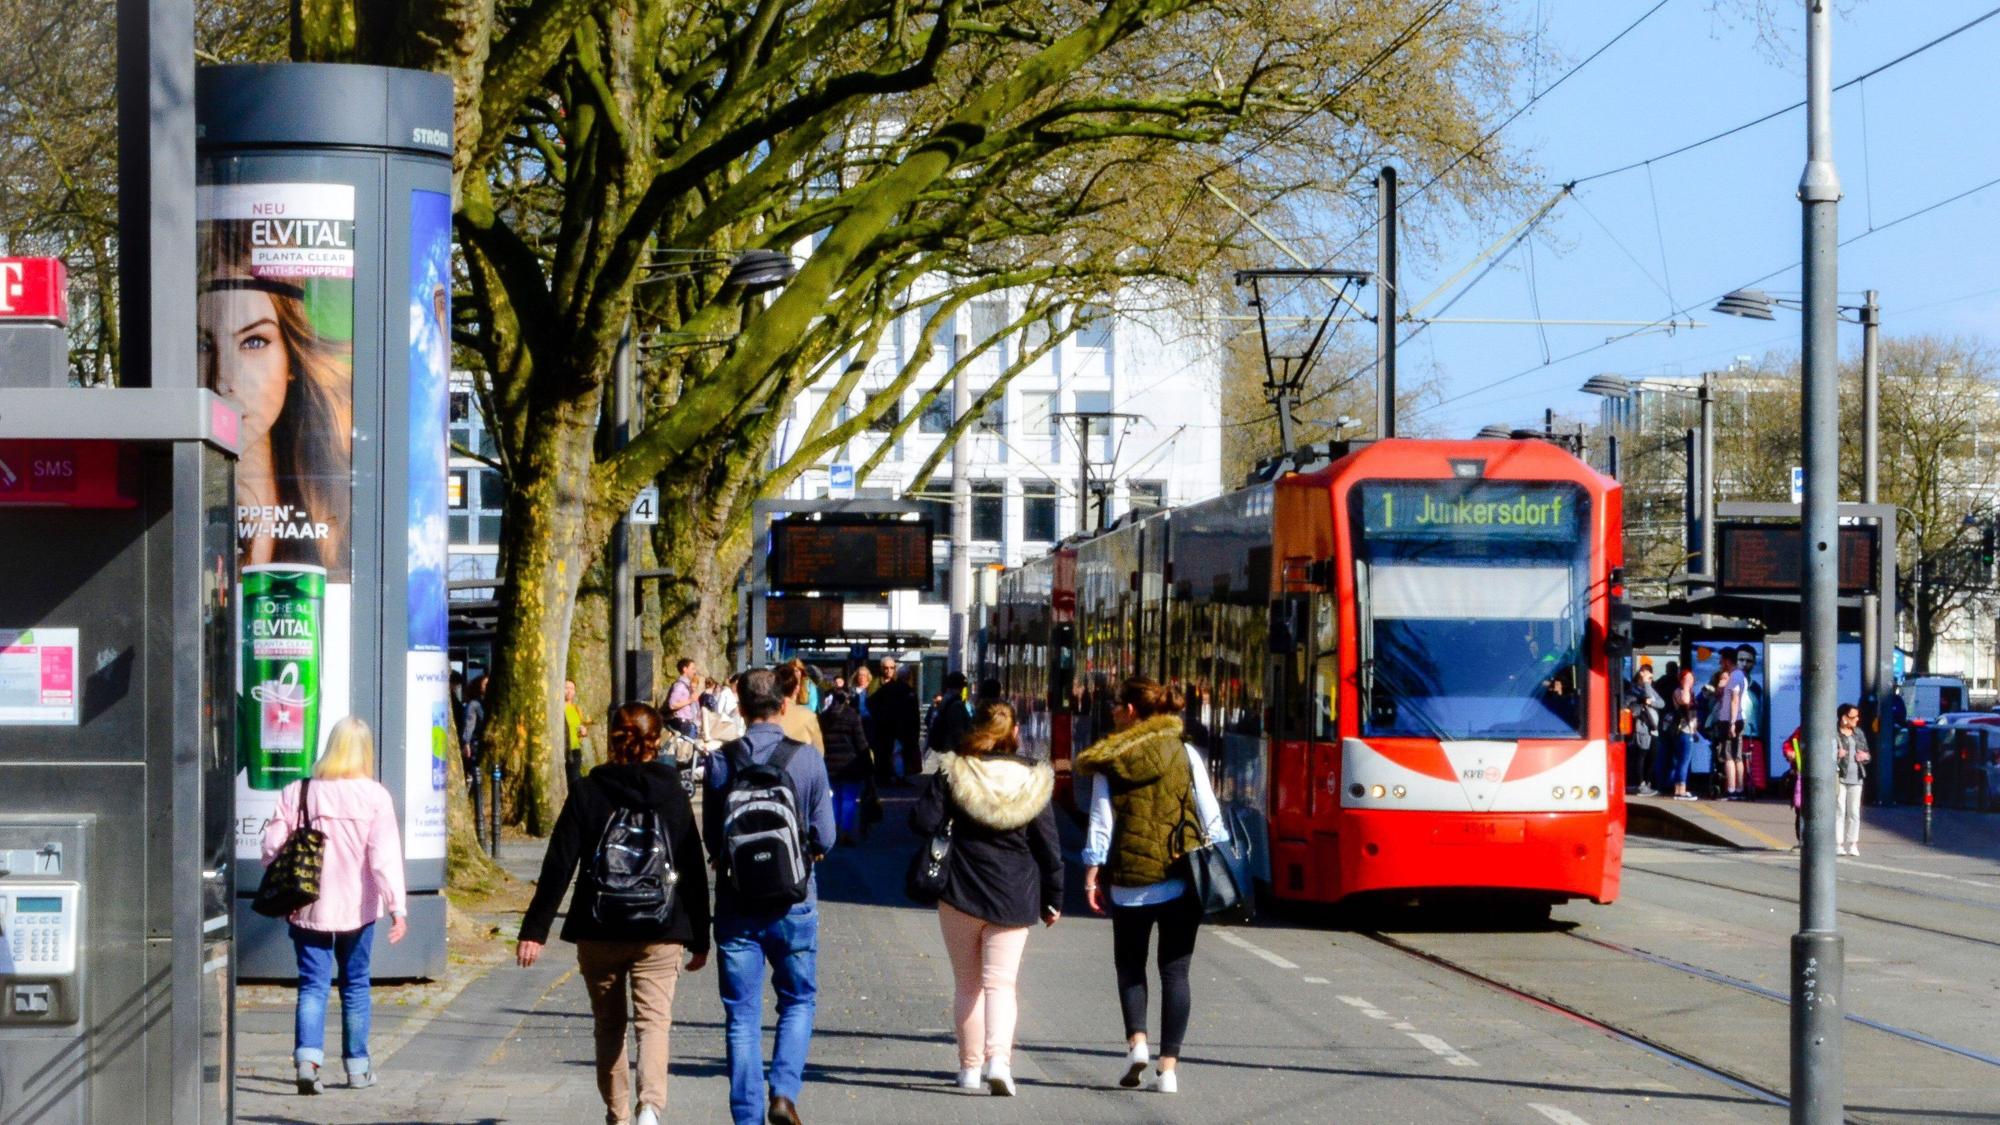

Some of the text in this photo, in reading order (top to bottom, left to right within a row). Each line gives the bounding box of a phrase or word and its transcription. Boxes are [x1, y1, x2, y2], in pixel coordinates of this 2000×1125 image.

[252, 203, 286, 215] NEU
[251, 219, 347, 248] ELVITAL
[258, 251, 346, 262] PLANTA CLEAR
[257, 265, 347, 277] ANTI-SCHUPPEN
[33, 460, 74, 478] SMS
[635, 499, 652, 519] 4
[1382, 492, 1562, 528] 1 Junkersdorf
[253, 619, 312, 636] ELVITAL
[1463, 769, 1484, 780] KVB
